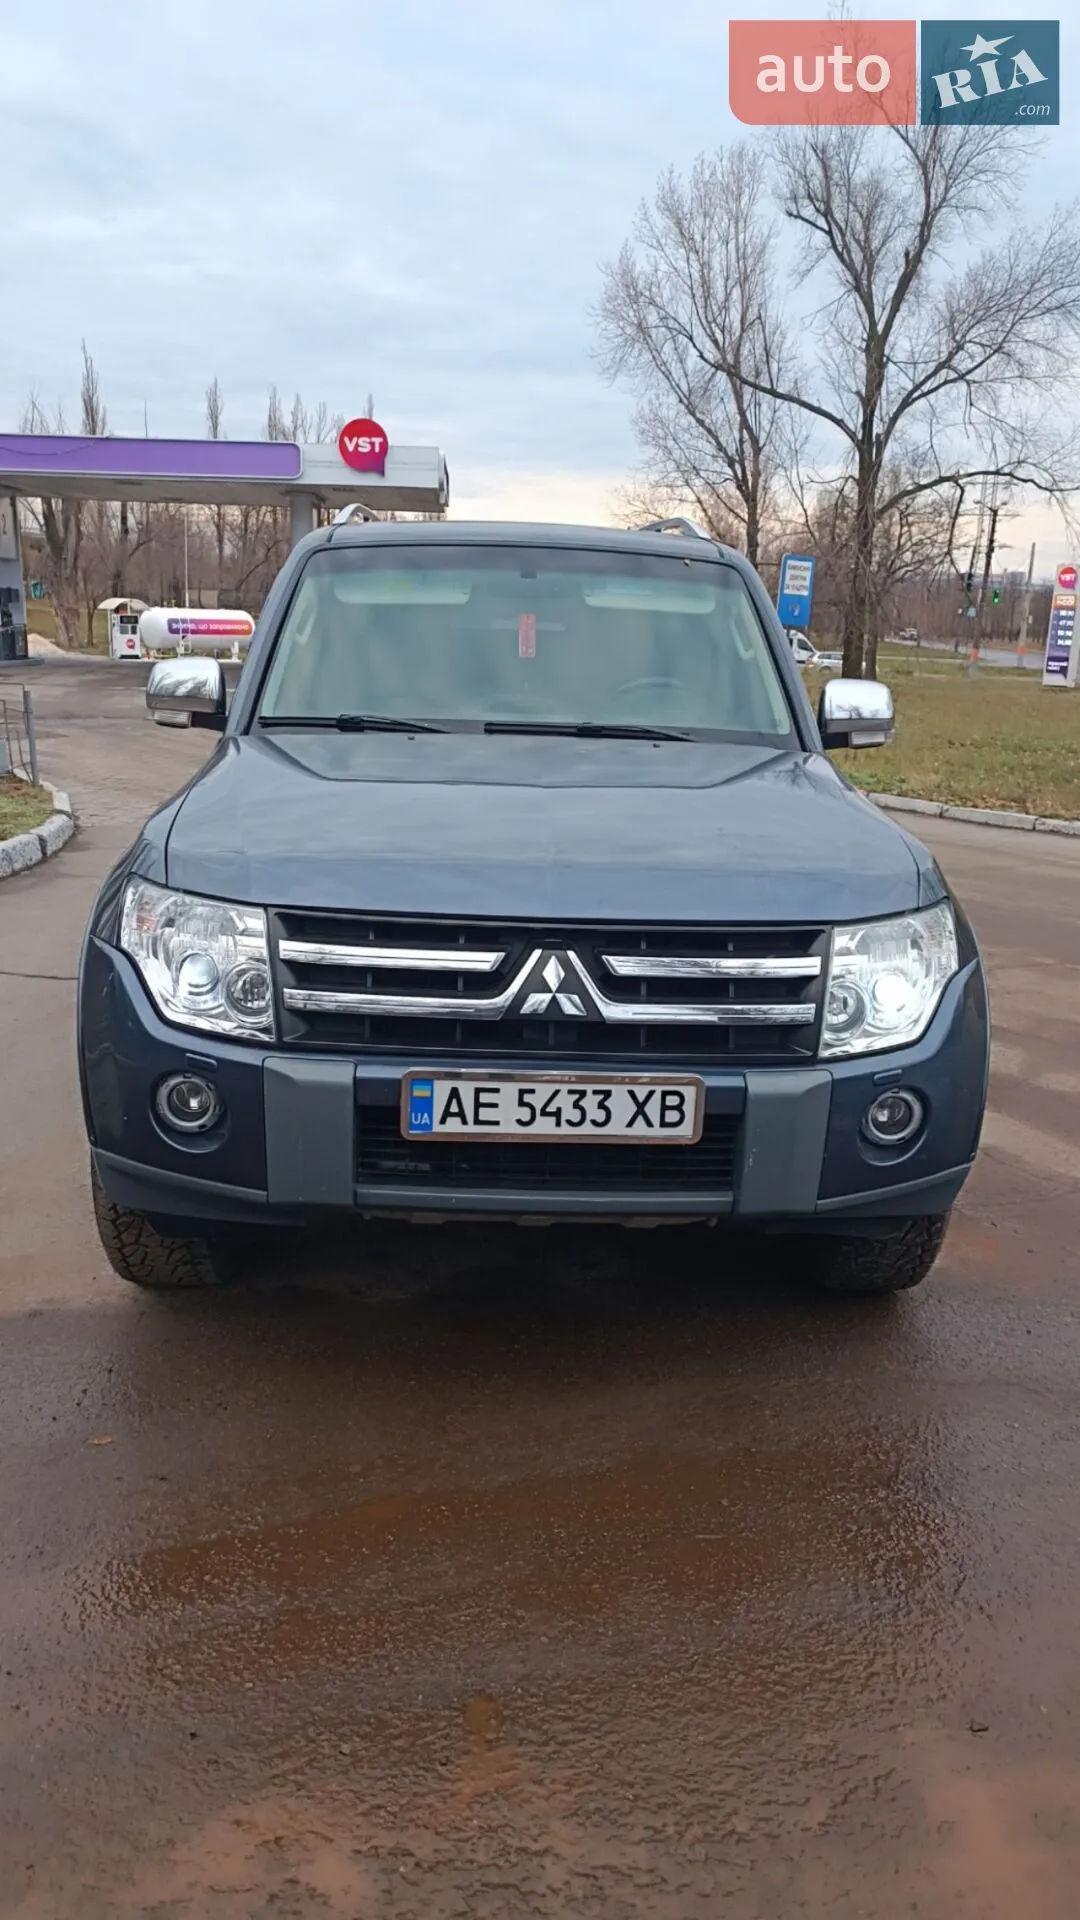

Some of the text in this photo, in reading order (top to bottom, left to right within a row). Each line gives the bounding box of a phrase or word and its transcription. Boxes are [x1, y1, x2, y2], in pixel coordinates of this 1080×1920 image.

[344, 436, 384, 453] VST
[411, 1086, 686, 1128] UA AE 5433 XB
